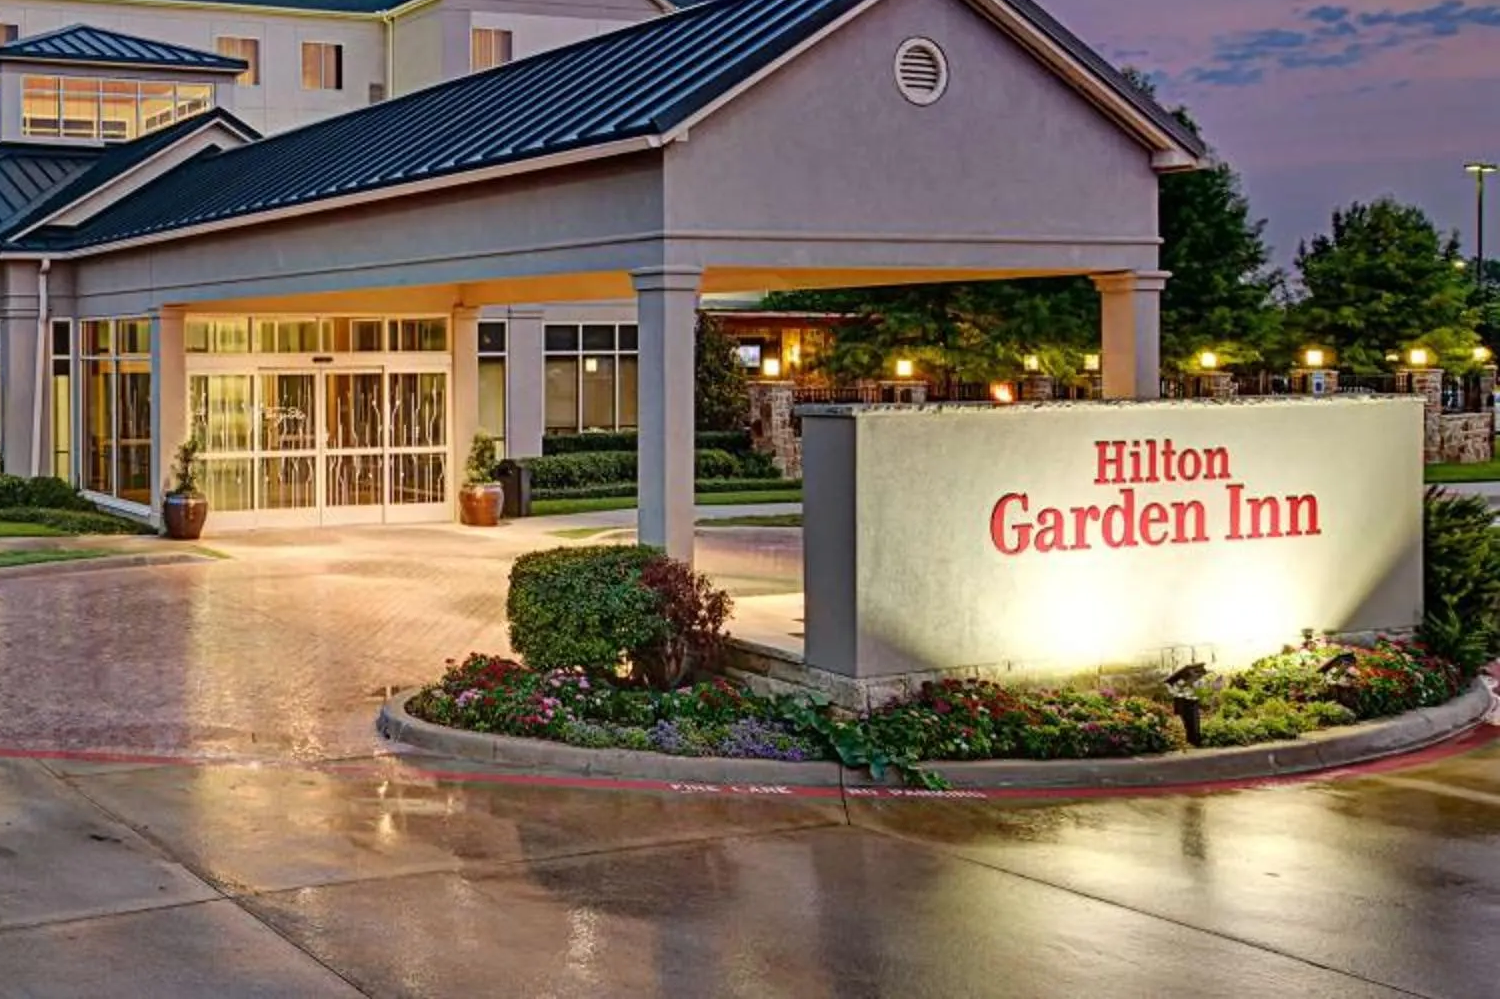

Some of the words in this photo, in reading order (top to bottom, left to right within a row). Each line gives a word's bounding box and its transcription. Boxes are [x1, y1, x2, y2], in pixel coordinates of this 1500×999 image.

[1094, 439, 1231, 485] Hilton
[989, 489, 1208, 556] Garden
[1225, 484, 1322, 539] Inn
